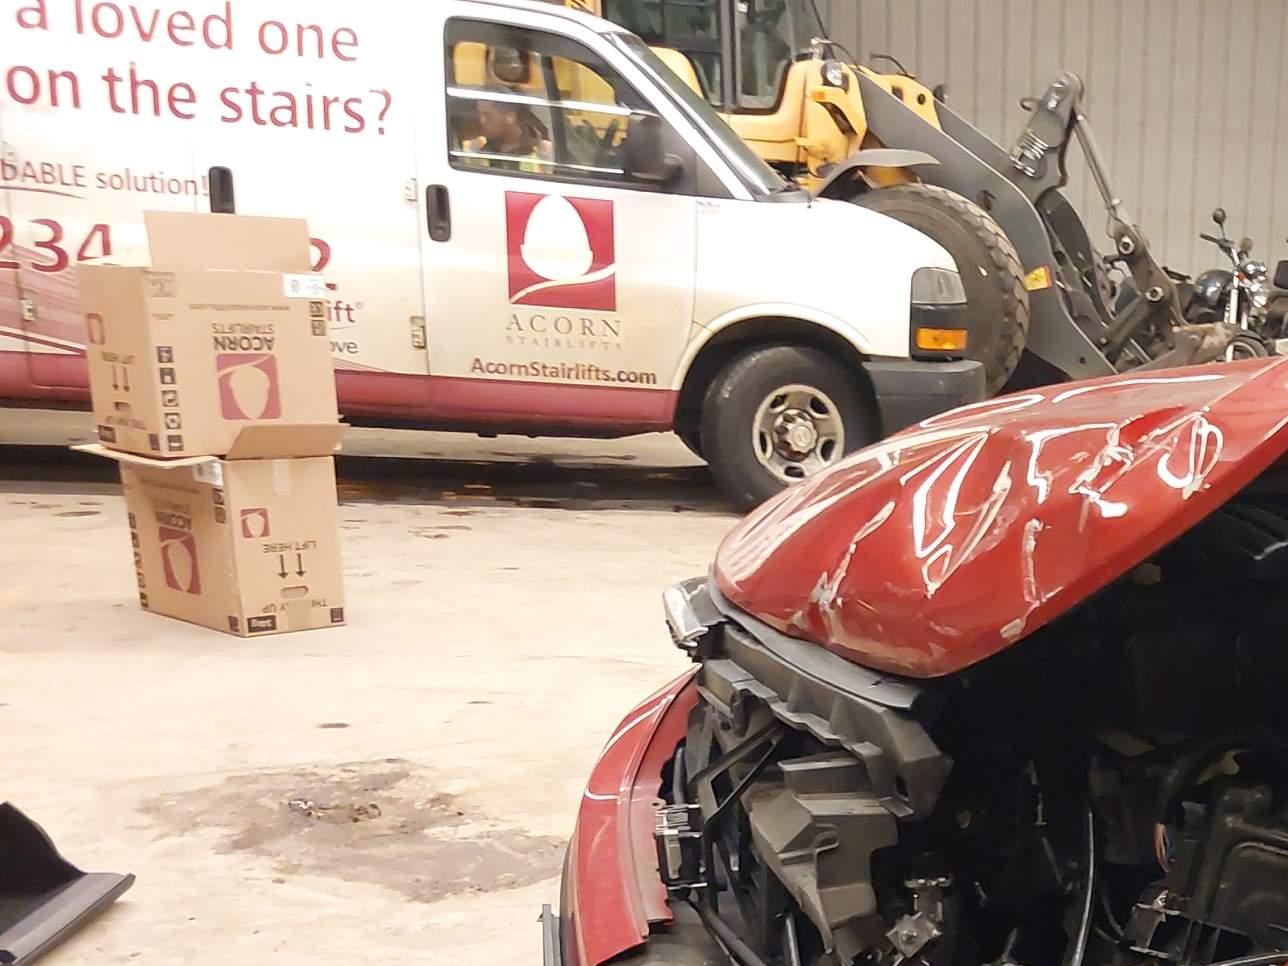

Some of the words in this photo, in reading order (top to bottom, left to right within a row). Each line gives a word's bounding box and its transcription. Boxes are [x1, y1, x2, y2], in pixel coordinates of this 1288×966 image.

[75, 0, 233, 50] loved
[258, 20, 359, 62] one
[6, 65, 81, 109] on
[101, 62, 197, 120] the
[220, 81, 392, 135] stairs?
[506, 314, 621, 337] ACORN
[213, 335, 276, 352] ACORN
[505, 335, 624, 351] STAIRLIFTS
[472, 357, 657, 385] AcornStairlifts.com
